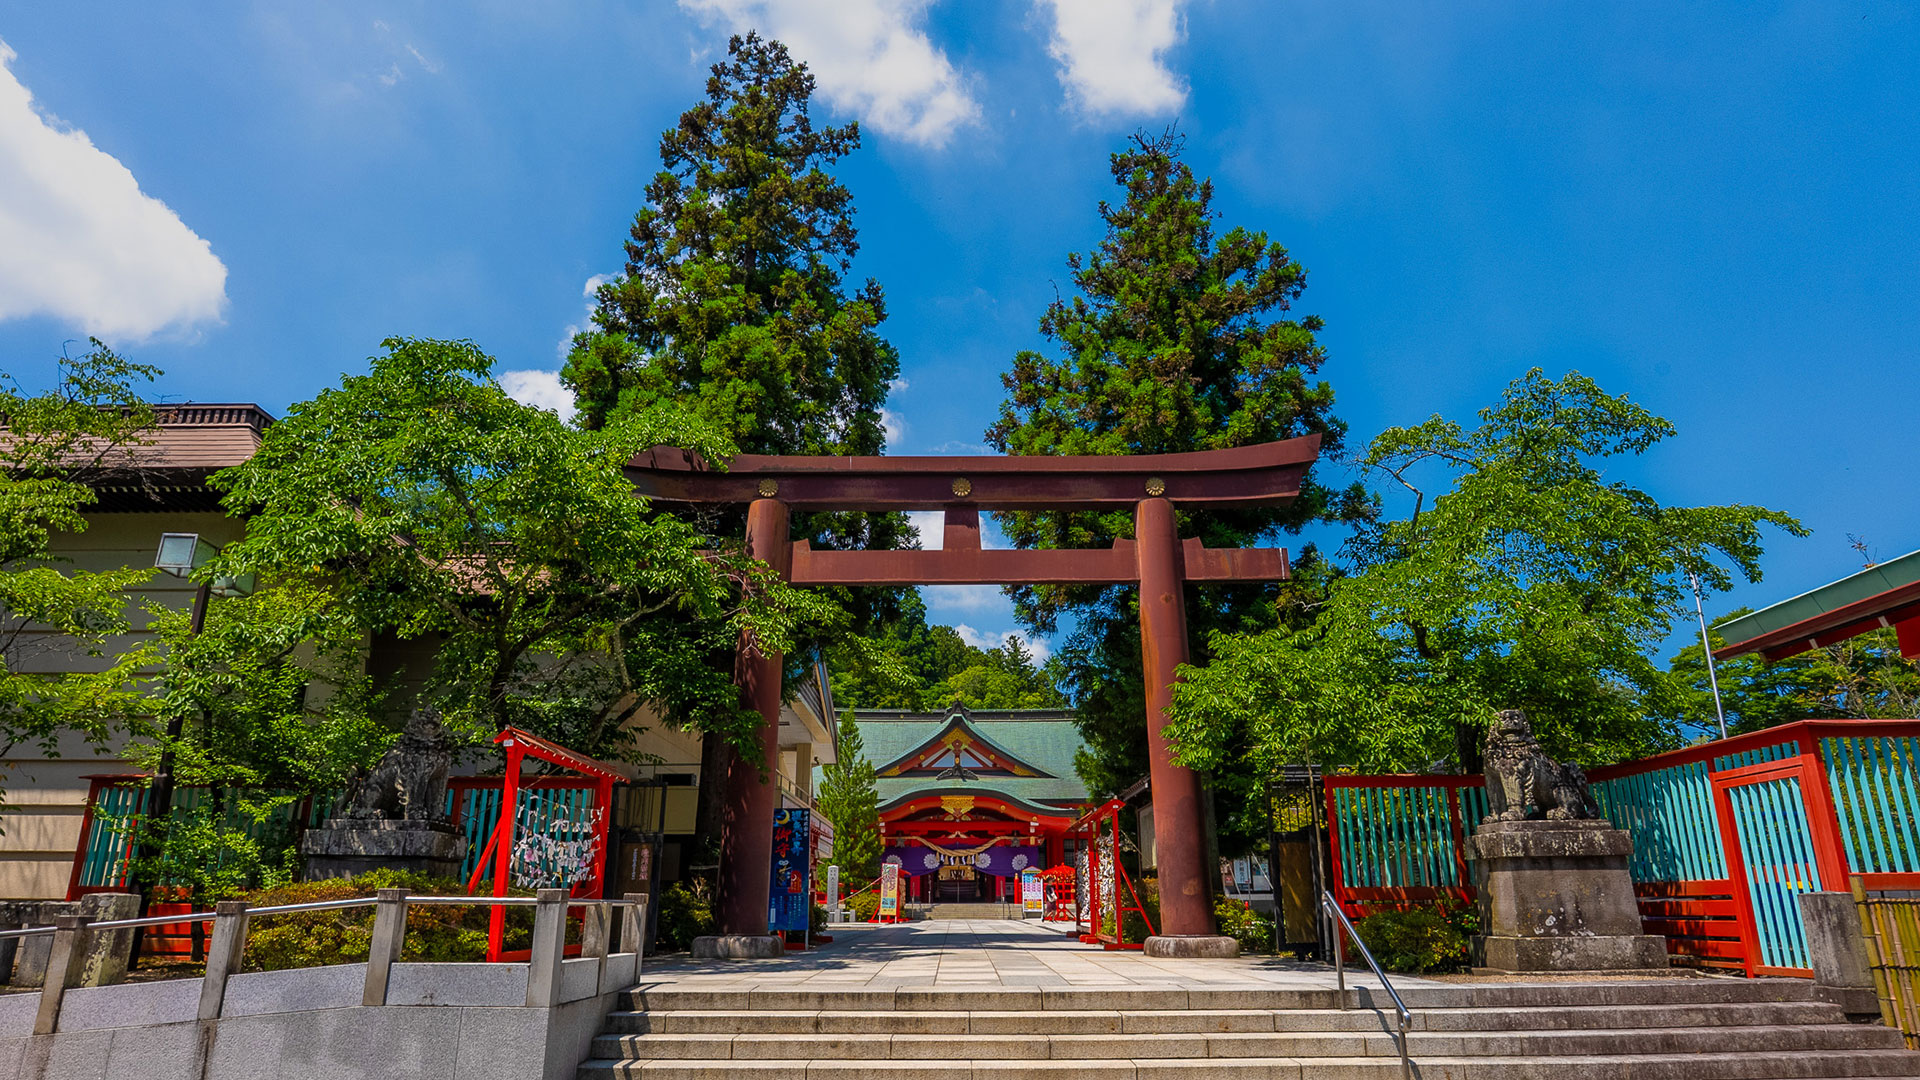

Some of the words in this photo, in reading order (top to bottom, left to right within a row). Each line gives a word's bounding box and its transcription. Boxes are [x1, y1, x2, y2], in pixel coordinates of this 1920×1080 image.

[775, 827, 792, 858] 御守
[791, 810, 803, 857] 運気上昇
